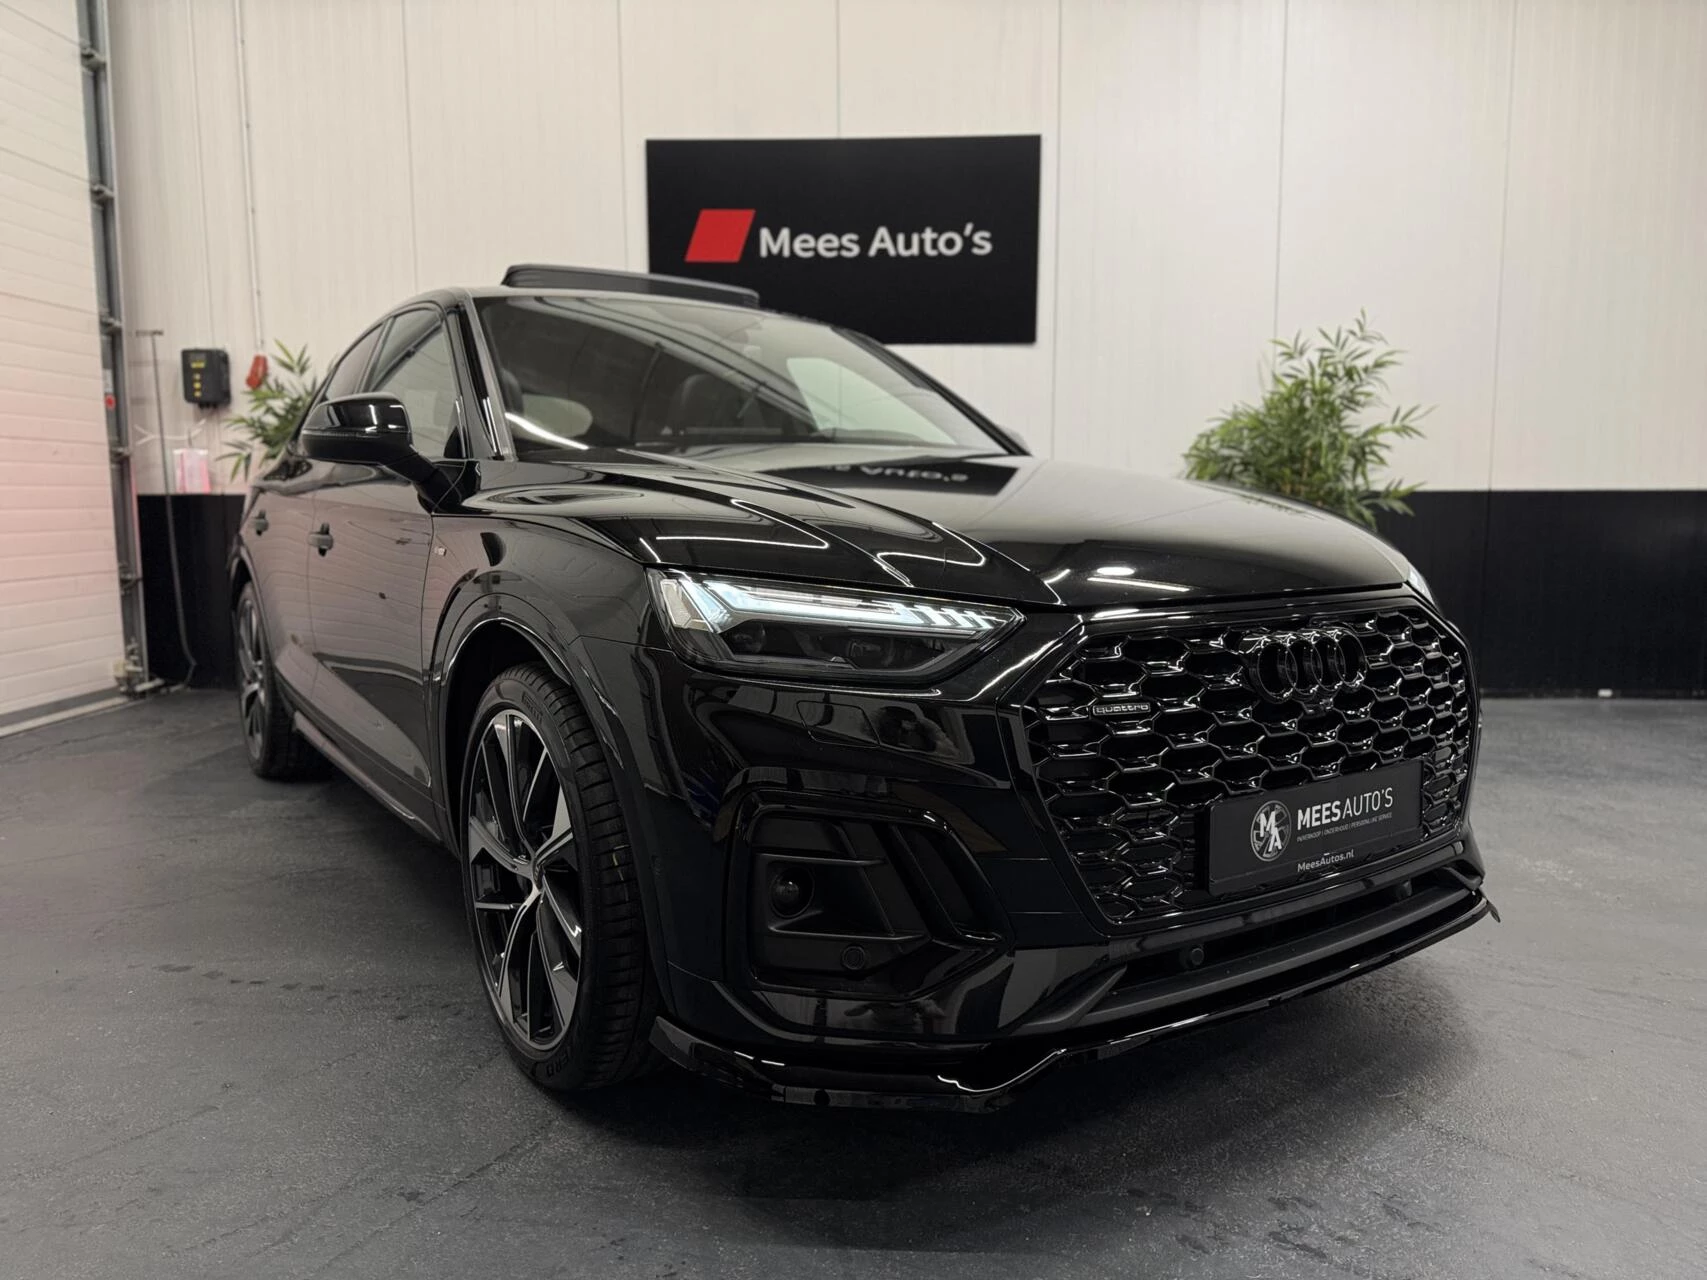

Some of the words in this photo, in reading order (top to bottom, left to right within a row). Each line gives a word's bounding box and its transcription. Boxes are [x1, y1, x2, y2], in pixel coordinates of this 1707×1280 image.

[760, 228, 860, 258] Mees
[868, 223, 992, 257] Auto's
[1096, 704, 1149, 714] quattro
[1297, 849, 1354, 872] MeesAutos.nl
